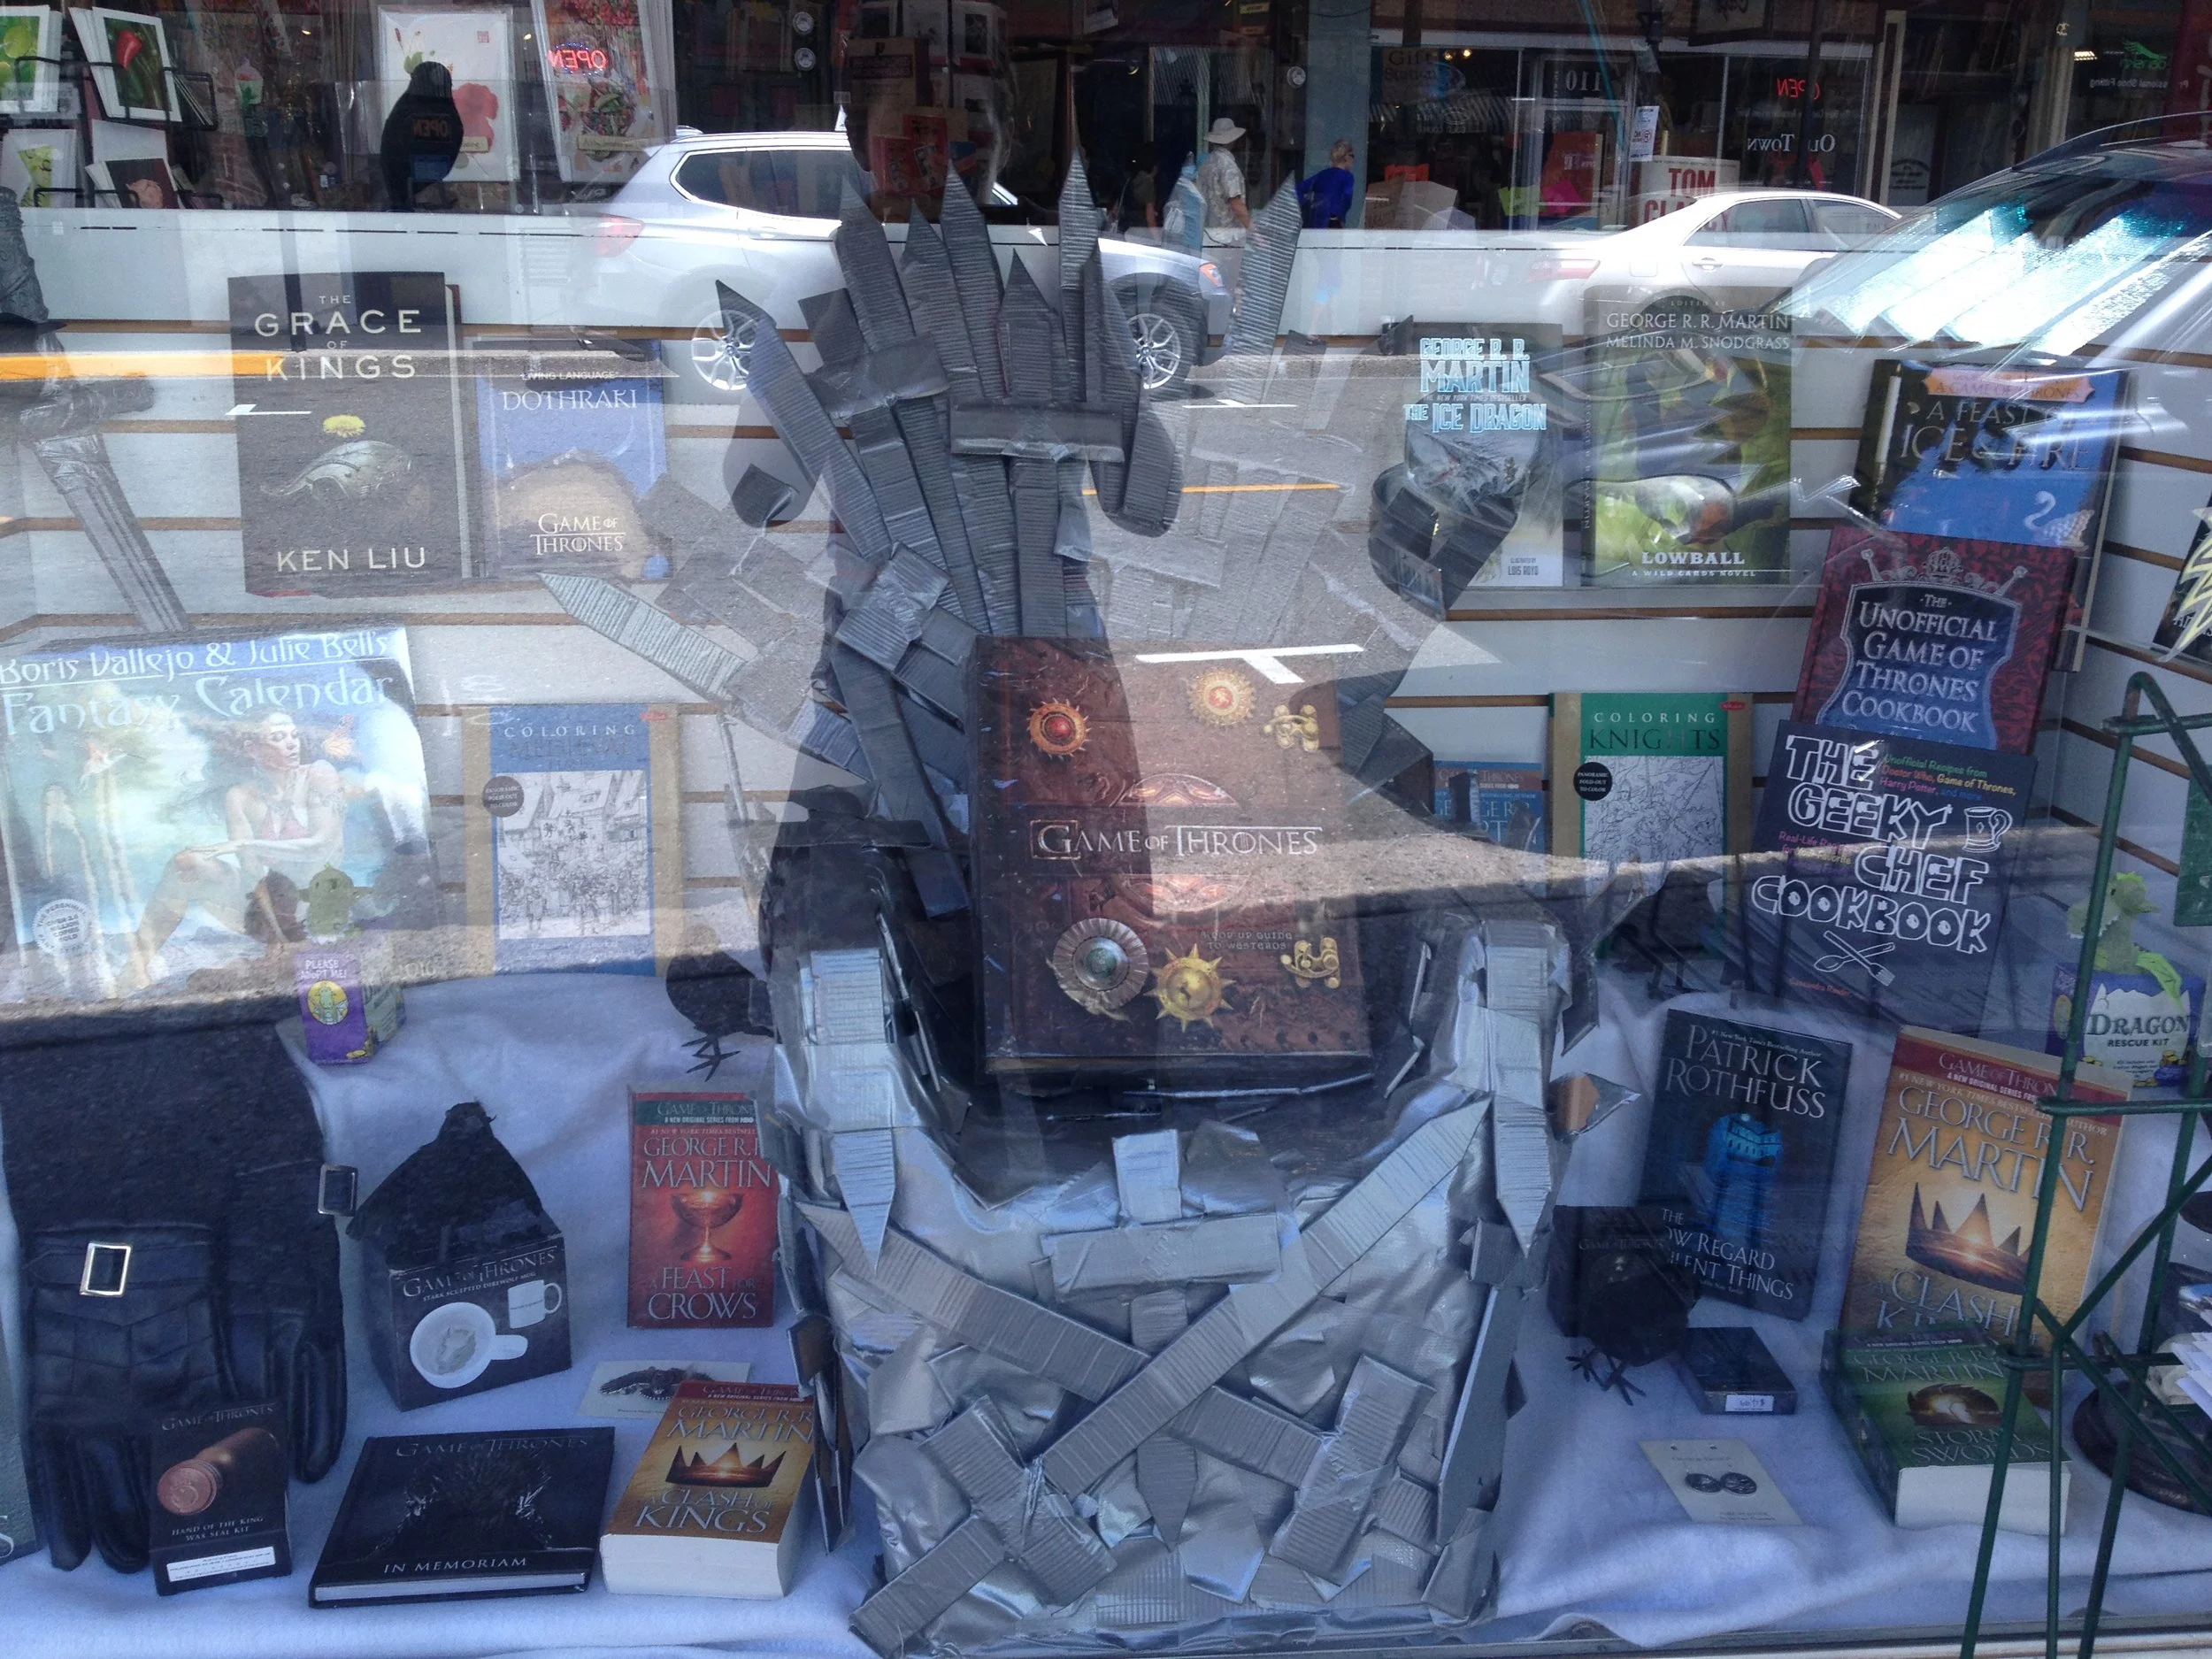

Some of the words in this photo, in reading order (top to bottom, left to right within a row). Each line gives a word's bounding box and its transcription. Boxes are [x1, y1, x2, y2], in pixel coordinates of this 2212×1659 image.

[1669, 168, 1716, 197] TOM
[319, 295, 351, 304] THE
[255, 310, 421, 336] GRACE
[1606, 312, 1677, 329] GEORGE
[1682, 313, 1696, 329] R.
[1701, 313, 1715, 329] R.
[1718, 314, 1788, 330] MARTIN
[326, 341, 348, 349] OF
[1419, 338, 1485, 360] GEORGE
[1489, 338, 1507, 360] R.
[1512, 338, 1531, 360] R.
[1606, 335, 1675, 349] MELINDA
[1681, 336, 1699, 349] M.
[1701, 336, 1790, 350] SNODGRASS
[266, 355, 416, 381] KINGS
[1420, 360, 1530, 393] MARTIN
[499, 389, 638, 411] DOTHRAKI
[1926, 401, 1945, 420] A
[1956, 402, 2028, 424] FEAST
[1402, 403, 1429, 421] THE
[1432, 403, 1464, 433] ICE
[1470, 403, 1547, 433] DRAGON
[1901, 424, 1965, 462] ICE
[538, 513, 602, 534] GAME
[603, 518, 618, 528] OF
[529, 533, 626, 555] THRONES
[277, 549, 349, 572] KEN
[368, 547, 425, 569] LIU
[1641, 551, 1746, 565] LOWBALL
[1924, 594, 1947, 608] THE
[1859, 601, 1999, 641] UNOFFICIAL
[88, 649, 194, 681] Vallejo
[205, 642, 237, 668] &
[250, 639, 309, 664] Julie
[321, 631, 389, 658] Bell's
[1863, 631, 1947, 665] GAME
[1949, 646, 1985, 671] OF
[1856, 660, 1979, 702] THRONES
[3, 692, 180, 735] Fantasy
[196, 666, 394, 717] Calendar
[1842, 690, 1978, 733] COOKBOOK
[1594, 711, 1716, 724] COLORING
[503, 725, 635, 738] COLORING
[1589, 728, 1721, 750] KNIGHTS
[1786, 734, 1880, 791] THE
[1884, 753, 1928, 769] Unofficial
[1929, 760, 1964, 776] Recipes
[1966, 765, 1988, 778] from
[1880, 777, 1907, 791] Harry
[1937, 773, 1962, 787] Game
[1964, 779, 1975, 788] of
[1975, 780, 2016, 796] Thrones,
[1787, 781, 1954, 849] GEEKY
[1037, 824, 1141, 854] GAME
[1144, 835, 1168, 850] OF
[1164, 825, 1323, 856] THRONES
[1855, 845, 1989, 905] CHEF
[1751, 875, 1992, 955] COOKBOOK
[305, 959, 339, 970] PLEASE
[2083, 1013, 2191, 1035] DRAGON
[2108, 1039, 2148, 1048] RESCUE
[2153, 1038, 2170, 1047] KIT
[1686, 1025, 1822, 1087] PATRICK
[1939, 1052, 1989, 1077] GAME
[1665, 1057, 1825, 1118] ROTHFUSS
[1899, 1072, 1909, 1081] #1
[1912, 1075, 1934, 1087] NEW
[1938, 1082, 1962, 1096] YORK
[1967, 1089, 1996, 1105] TIMES
[1953, 1074, 1967, 1083] NEW
[1969, 1077, 1998, 1092] ORIGINAL
[2000, 1086, 2023, 1098] SERIES
[657, 1102, 696, 1116] GAME
[1900, 1086, 2026, 1145] GEORGE
[644, 1137, 730, 1156] GEORGE
[733, 1138, 751, 1156] R.
[641, 1160, 771, 1189] MARTIN
[1888, 1117, 2093, 1211] MARTIN
[1661, 1208, 1685, 1225] THE
[472, 1245, 557, 1282] THRONES
[1697, 1233, 1775, 1271] REGARD
[662, 1267, 731, 1289] FEAST
[733, 1279, 756, 1288] FOR
[1727, 1264, 1793, 1300] THINGS
[648, 1292, 757, 1320] CROWS
[1892, 1270, 2016, 1336] CLASH
[1854, 1352, 1941, 1365] GEORGE
[1859, 1362, 2004, 1382] MARTIN
[703, 1386, 741, 1395] GAME
[162, 1417, 202, 1431] GAME
[212, 1403, 275, 1423] THRONES
[678, 1406, 764, 1420] GEORGE
[777, 1409, 794, 1423] R.
[666, 1419, 815, 1444] MARTIN
[396, 1440, 467, 1456] GAME
[487, 1435, 595, 1457] THRONES
[662, 1489, 752, 1508] CLASH
[172, 1526, 200, 1535] HAND
[634, 1506, 770, 1533] KINGS
[384, 1564, 406, 1573] IN
[415, 1557, 526, 1571] MEMORIAM
